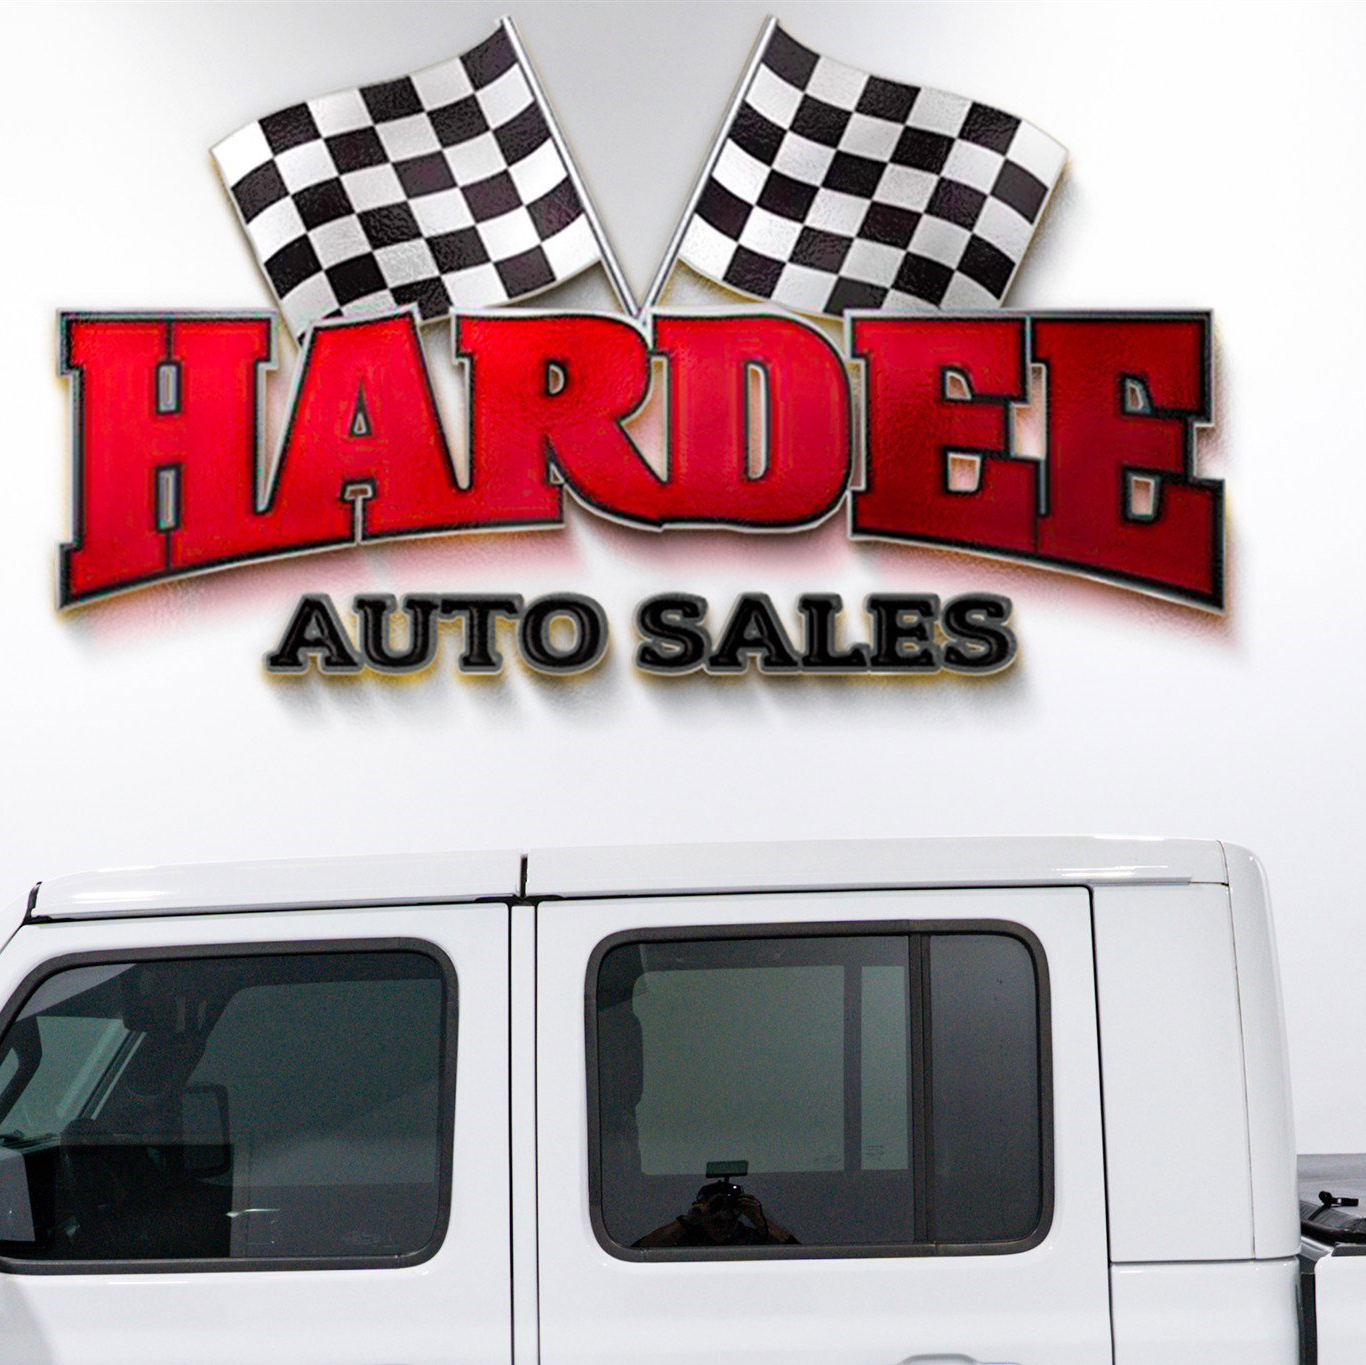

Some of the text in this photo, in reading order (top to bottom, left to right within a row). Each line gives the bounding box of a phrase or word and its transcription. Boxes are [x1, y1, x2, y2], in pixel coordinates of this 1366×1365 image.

[56, 307, 1227, 613] HARDEE
[263, 592, 1020, 675] AUTO SALES
